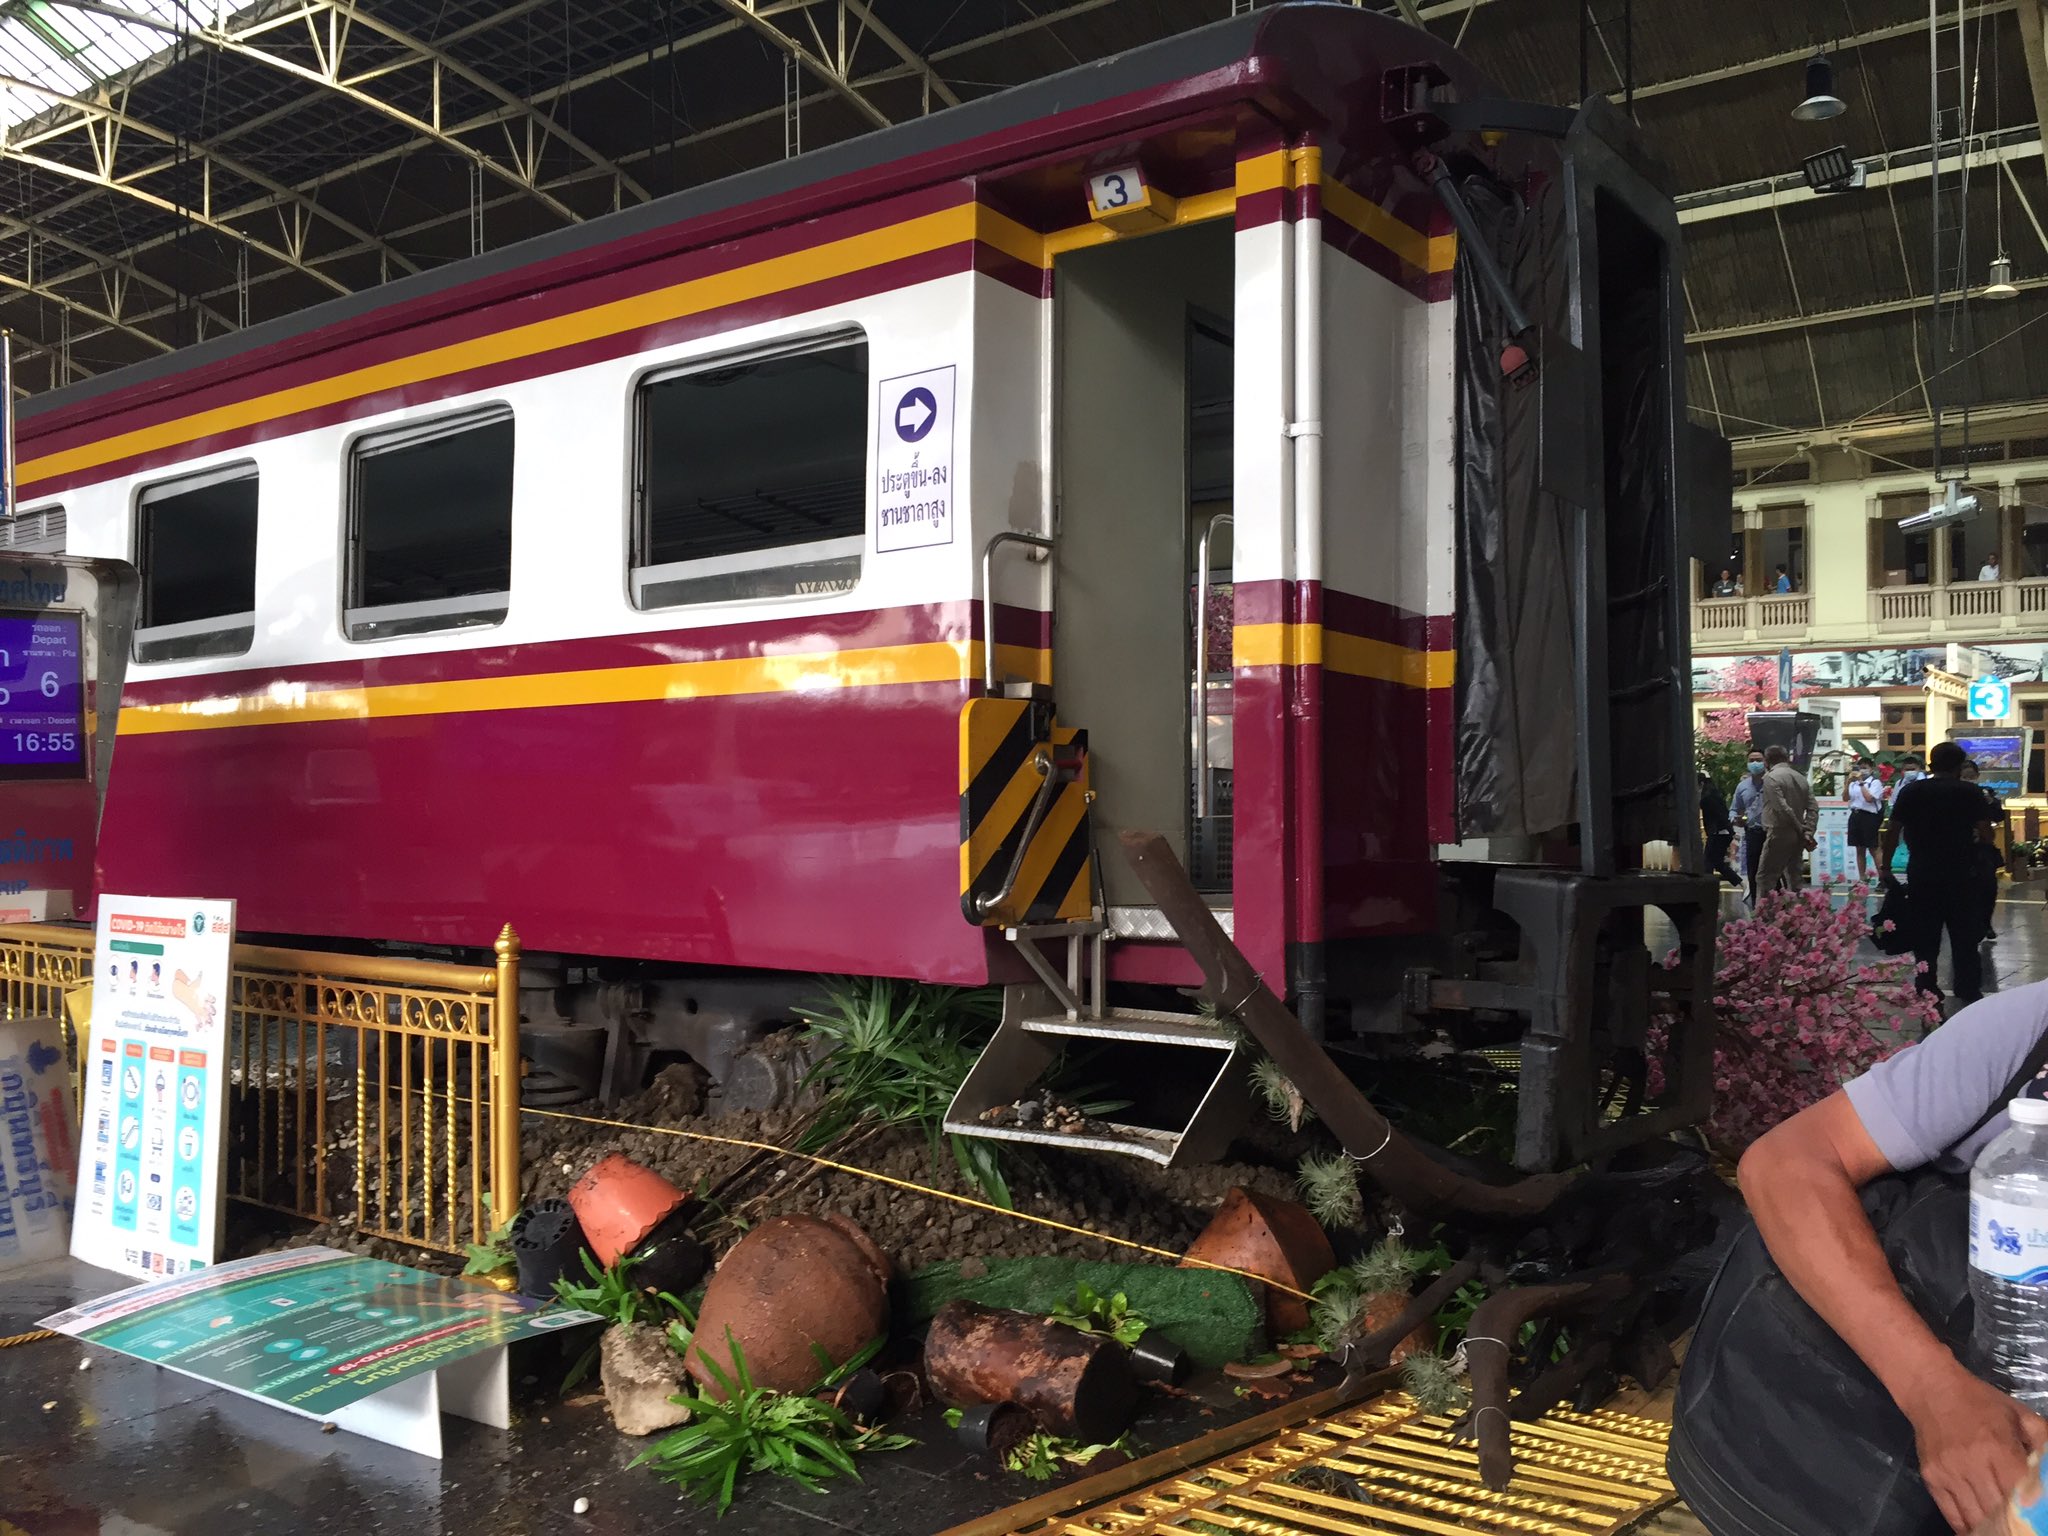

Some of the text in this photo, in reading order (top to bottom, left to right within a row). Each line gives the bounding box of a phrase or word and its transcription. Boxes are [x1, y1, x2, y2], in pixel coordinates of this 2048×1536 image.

[1104, 174, 1128, 207] 3
[881, 451, 947, 499] ประตูขึ้น-ลง
[881, 499, 946, 528] ชานชาลาสูง
[32, 635, 67, 646] Depart
[41, 671, 59, 698] 6
[1974, 684, 2005, 718] 3
[13, 733, 75, 751] 16:55
[338, 1343, 408, 1373] COVID-19
